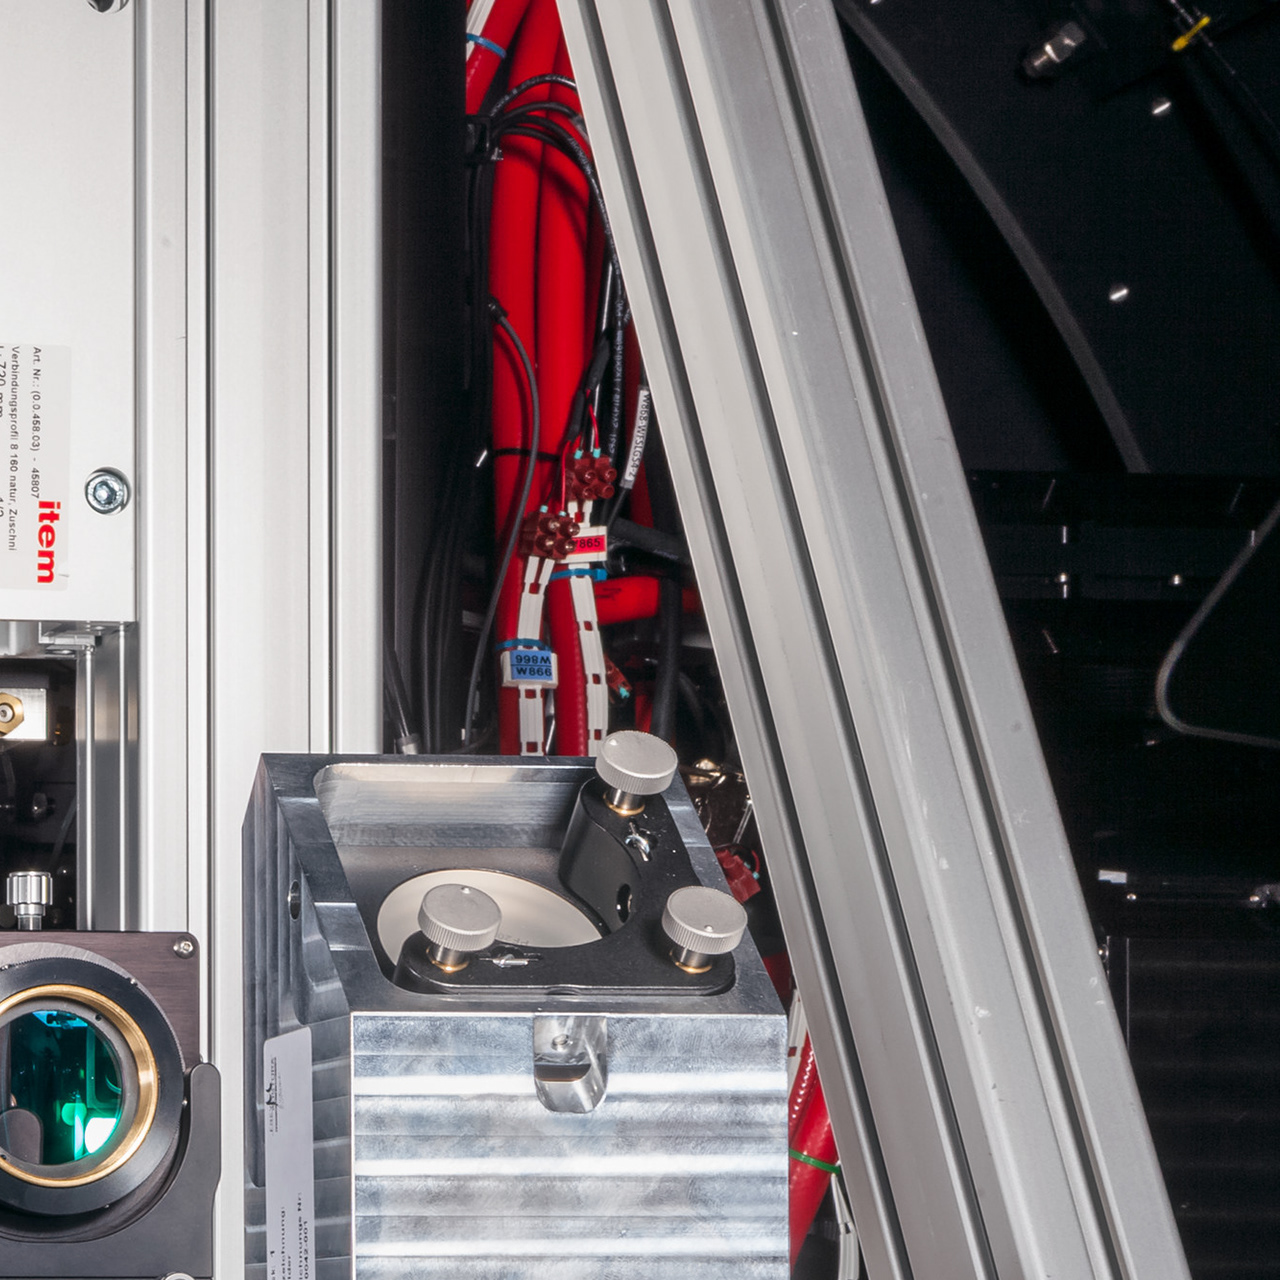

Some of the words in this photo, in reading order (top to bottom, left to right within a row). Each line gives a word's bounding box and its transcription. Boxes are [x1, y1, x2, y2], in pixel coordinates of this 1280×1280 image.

[31, 346, 42, 364] Art.
[8, 346, 20, 441] Verbindungsprofil
[30, 390, 41, 452] (0.0.458.03)
[10, 454, 18, 472] 160
[8, 475, 18, 506] natur,
[31, 467, 40, 498] 45807
[8, 508, 18, 551] Zuschni
[37, 500, 61, 584] item
[515, 655, 551, 664] W866
[516, 667, 552, 676] W866
